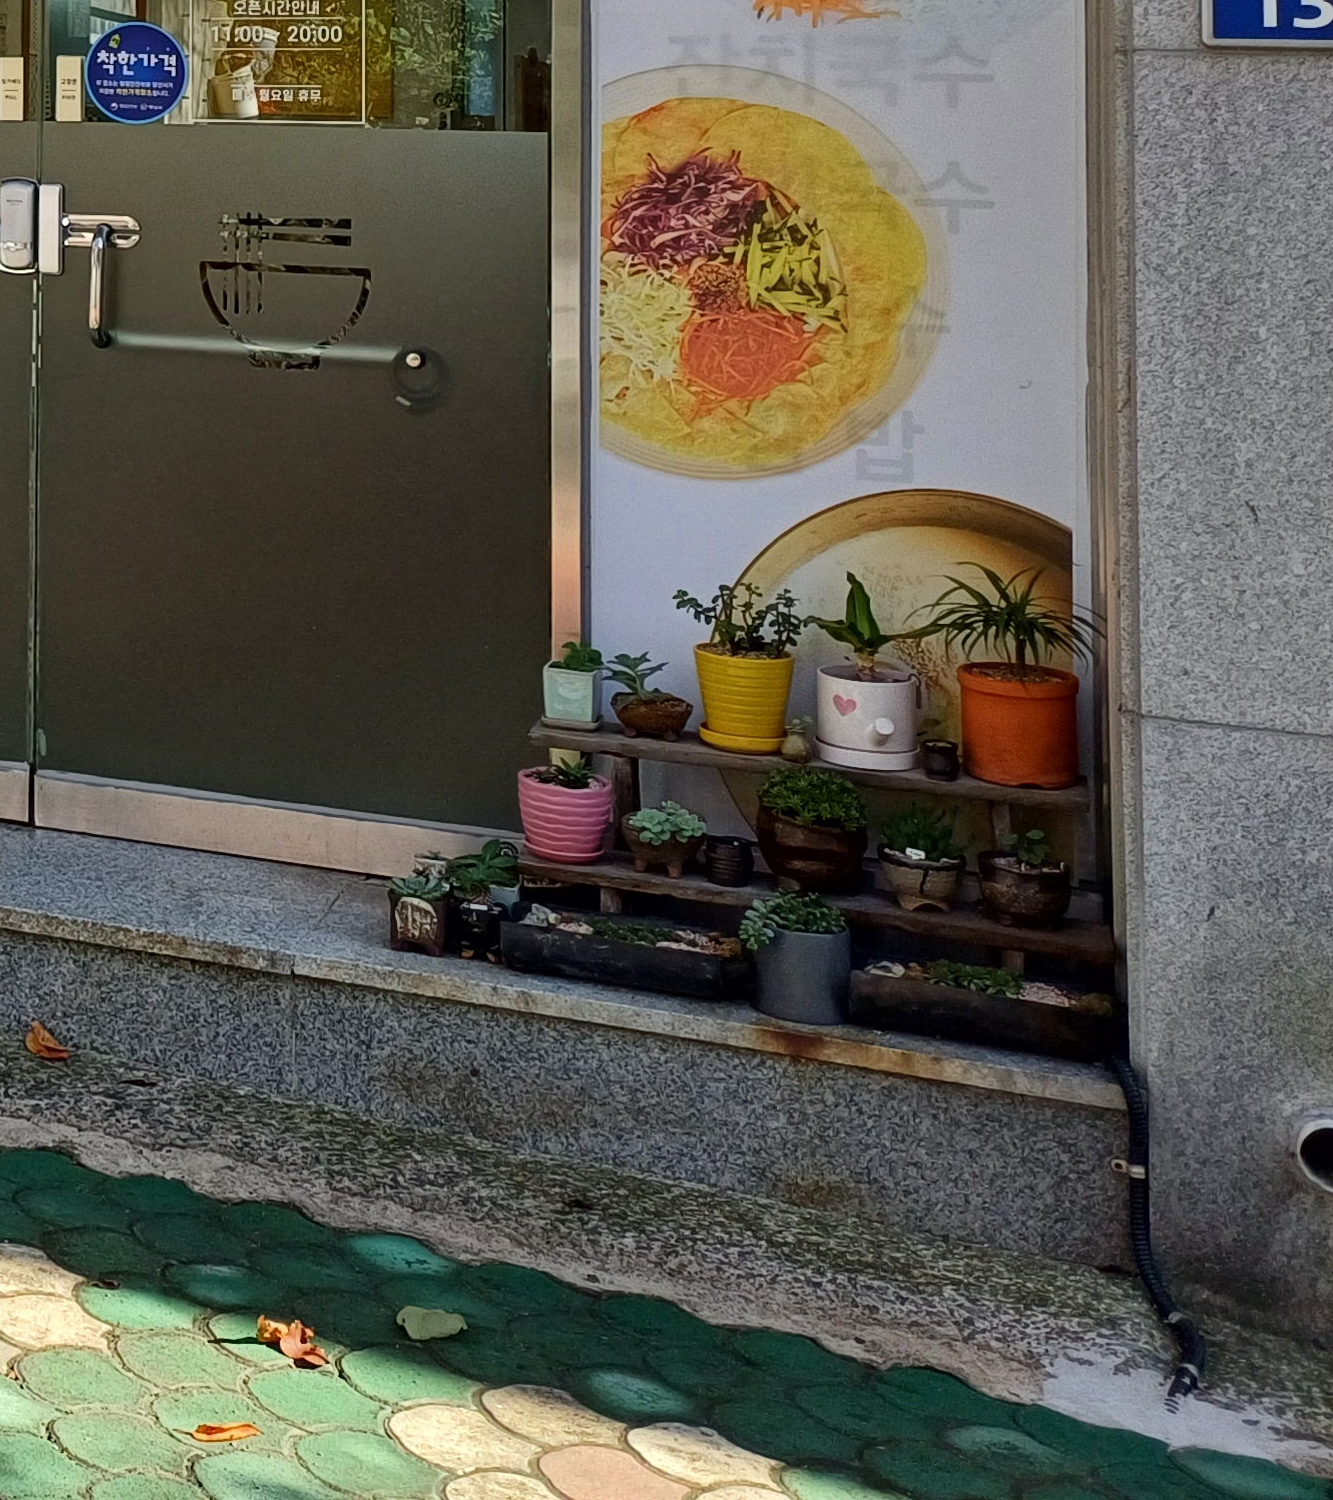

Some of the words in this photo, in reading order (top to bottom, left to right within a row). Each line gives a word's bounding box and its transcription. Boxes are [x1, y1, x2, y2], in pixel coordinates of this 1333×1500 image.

[233, 0, 320, 16] 오픈시간안내
[96, 49, 177, 77] 착한가격
[259, 88, 294, 102] 월요일
[298, 88, 322, 103] 휴무
